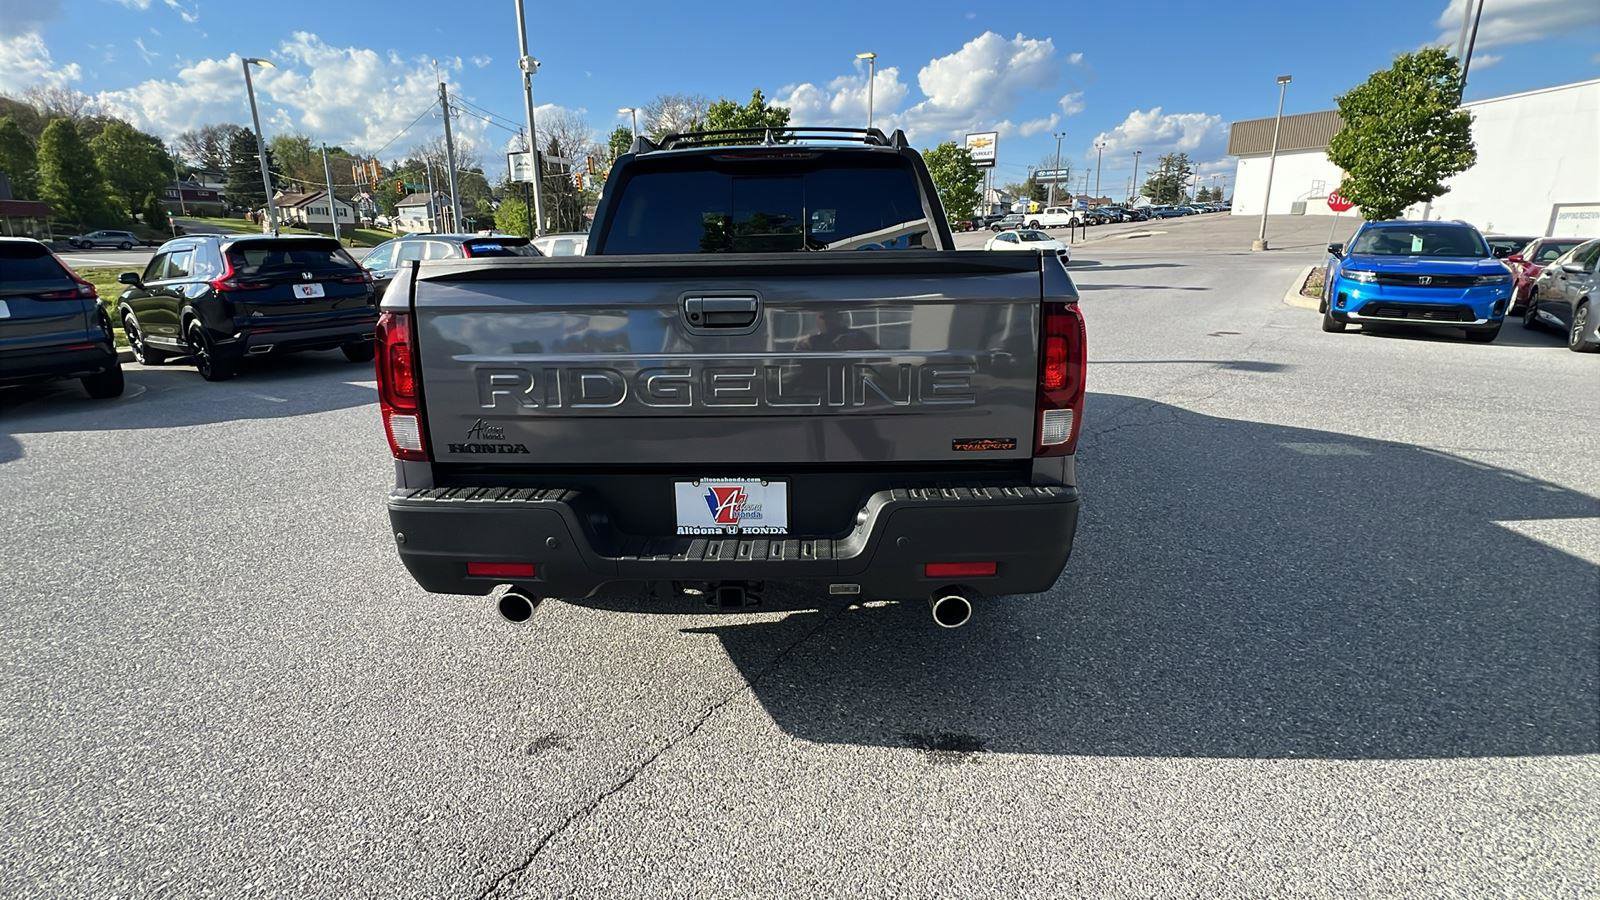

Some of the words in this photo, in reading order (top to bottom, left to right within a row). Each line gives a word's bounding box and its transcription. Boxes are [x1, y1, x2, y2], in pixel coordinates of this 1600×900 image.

[1329, 194, 1352, 204] STO
[474, 365, 977, 409] RIDGELINE
[448, 443, 530, 454] HONDA
[676, 526, 723, 535] Altoona
[742, 526, 788, 535] HONDA
